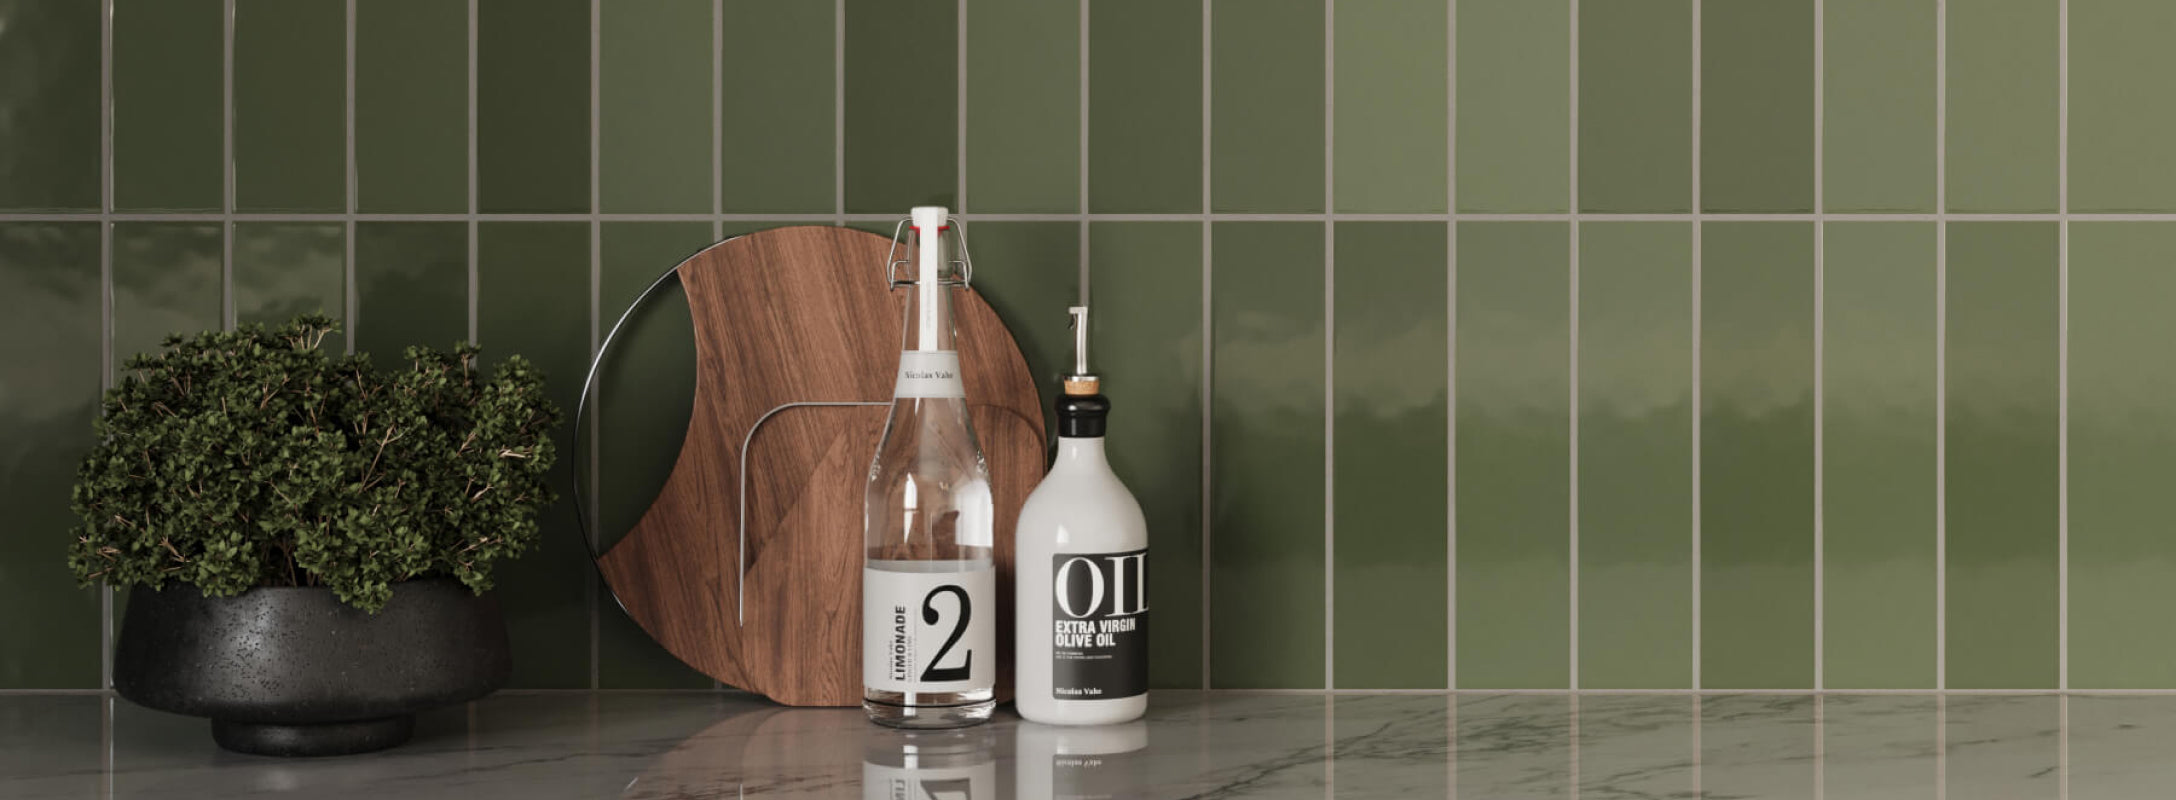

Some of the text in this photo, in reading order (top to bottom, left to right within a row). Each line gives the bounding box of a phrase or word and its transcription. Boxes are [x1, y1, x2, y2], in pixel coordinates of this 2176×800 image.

[895, 605, 906, 681] LIMONADE
[920, 585, 972, 682] 2
[1055, 633, 1116, 647] OLIVE OIL
[1056, 618, 1136, 634] EXTRA VIRGIN
